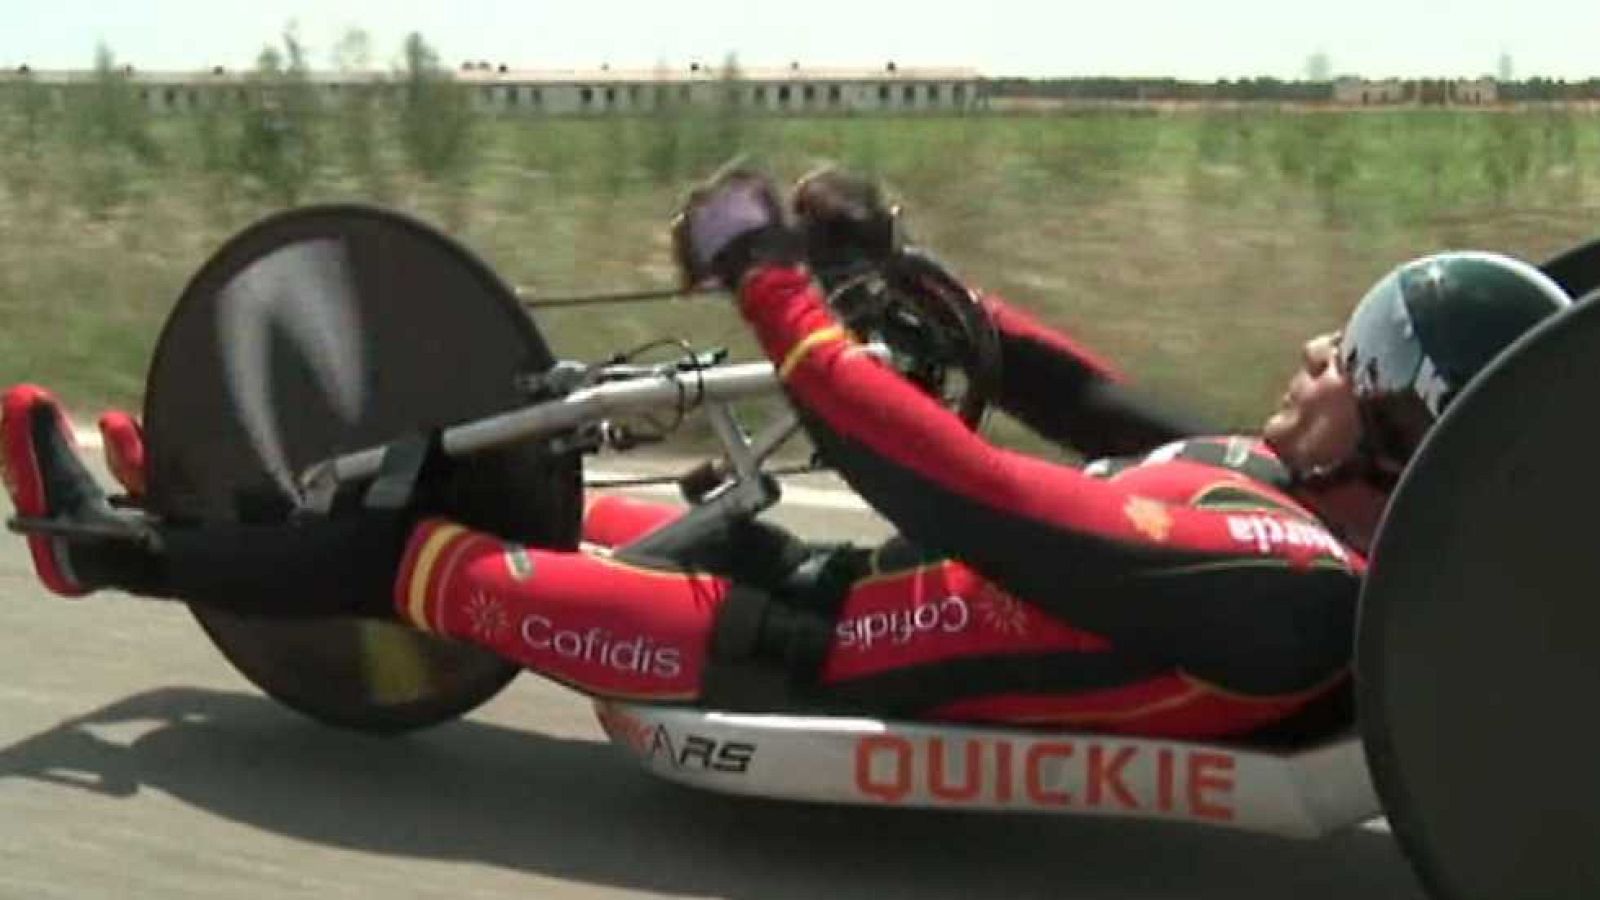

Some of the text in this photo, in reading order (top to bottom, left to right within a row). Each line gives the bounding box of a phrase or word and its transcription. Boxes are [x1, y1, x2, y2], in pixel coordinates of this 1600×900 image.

[520, 614, 681, 677] Cofidis
[837, 595, 969, 650] Cofidis
[854, 734, 1235, 821] QUICKIE
